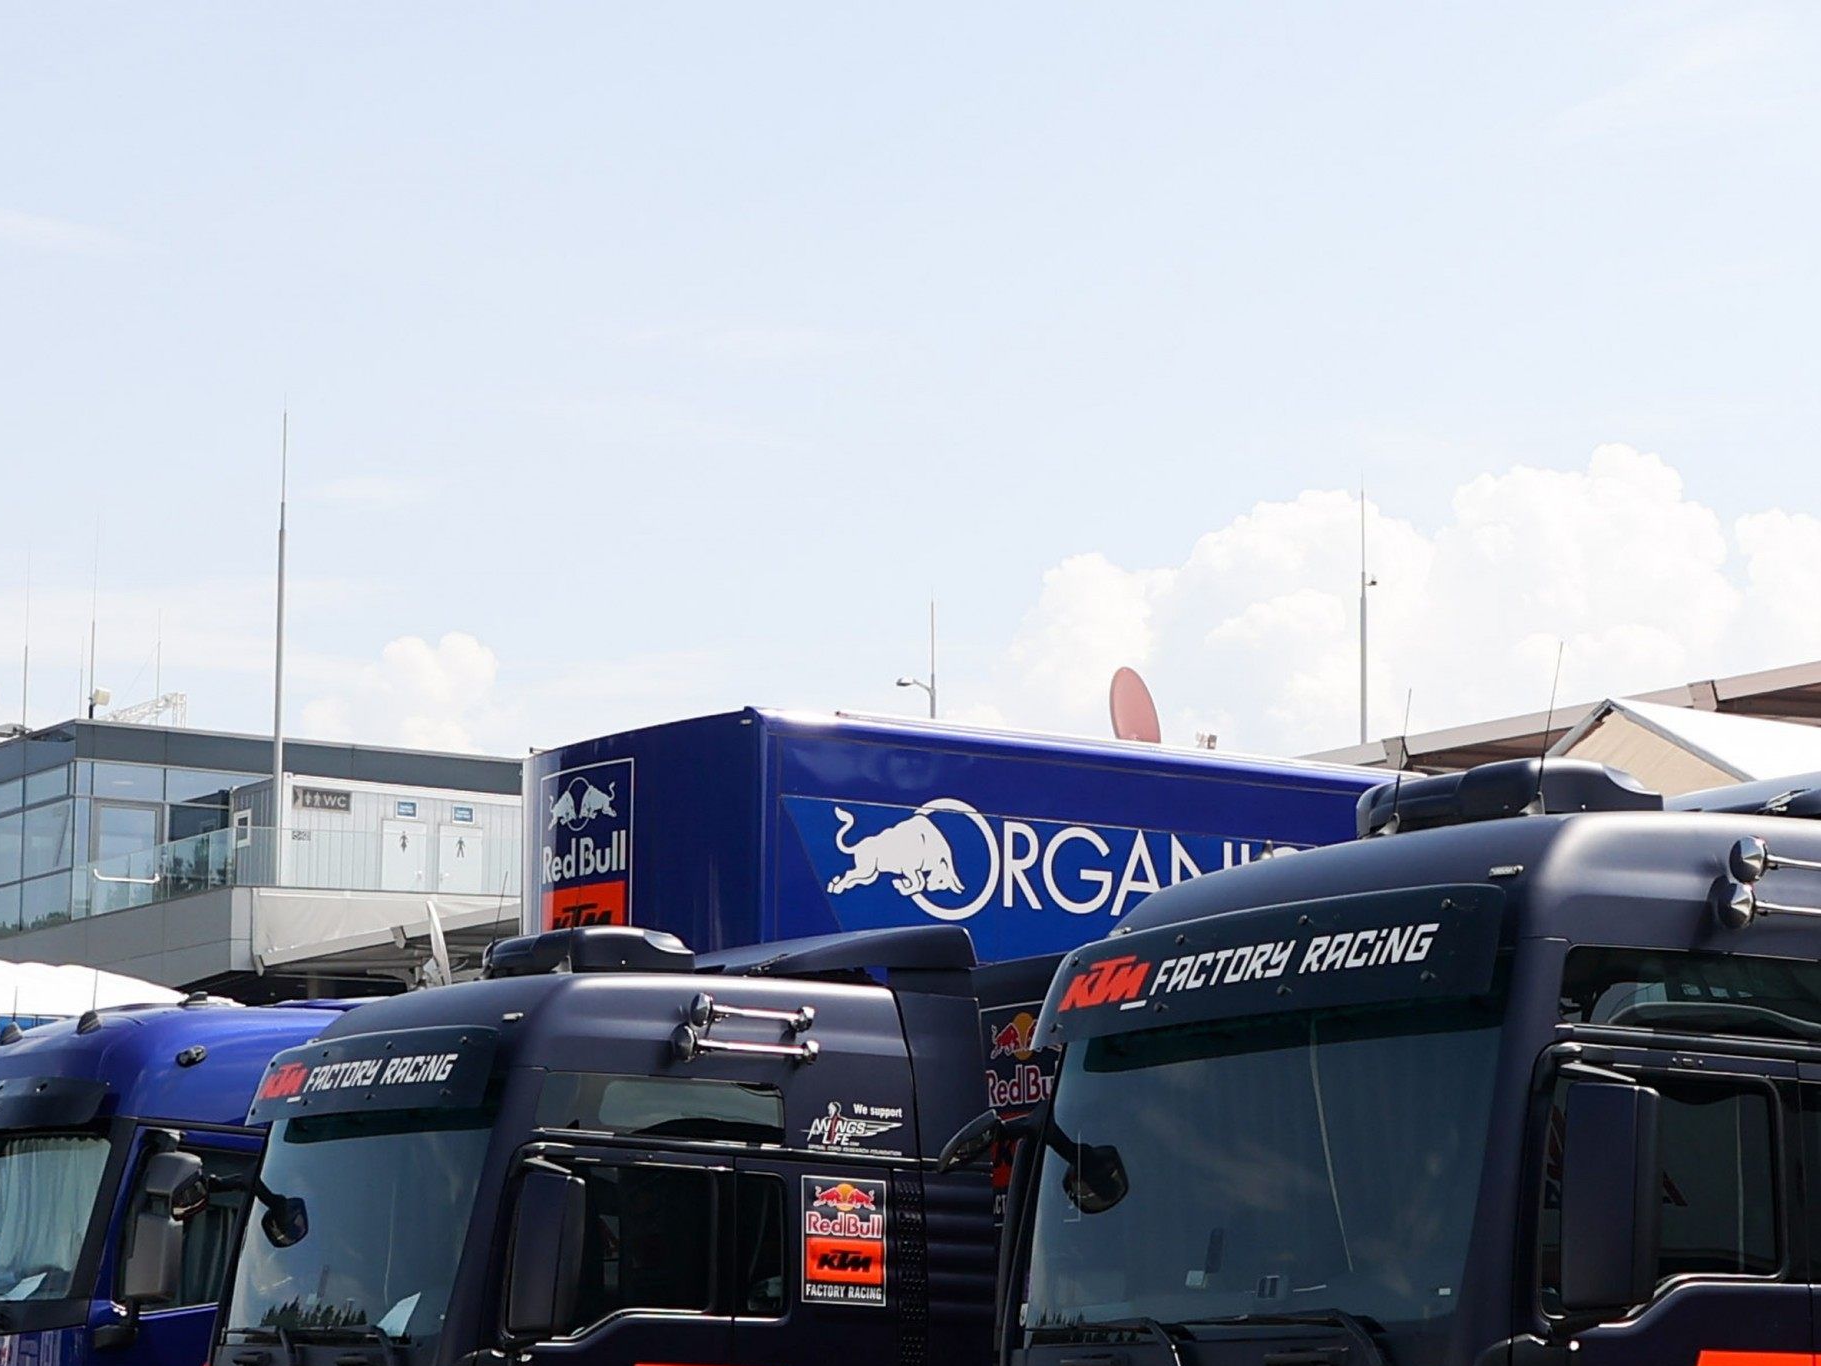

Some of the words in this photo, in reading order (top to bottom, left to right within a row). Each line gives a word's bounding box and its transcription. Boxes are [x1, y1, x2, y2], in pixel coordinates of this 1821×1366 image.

[323, 793, 348, 808] WC
[542, 837, 576, 885] Red
[579, 829, 627, 876] Bull
[1057, 955, 1153, 1014] KTM
[1149, 940, 1297, 997] FACTORY
[260, 1062, 308, 1099] KTM
[303, 1058, 383, 1094] FACTORY
[985, 1064, 1023, 1109] Red
[852, 1103, 868, 1115] We
[870, 1106, 903, 1120] support
[806, 1211, 845, 1237] Red
[845, 1213, 883, 1239] Bull
[816, 1248, 873, 1273] KTM
[805, 1283, 847, 1298] FACTORY
[847, 1285, 882, 1300] RACING
